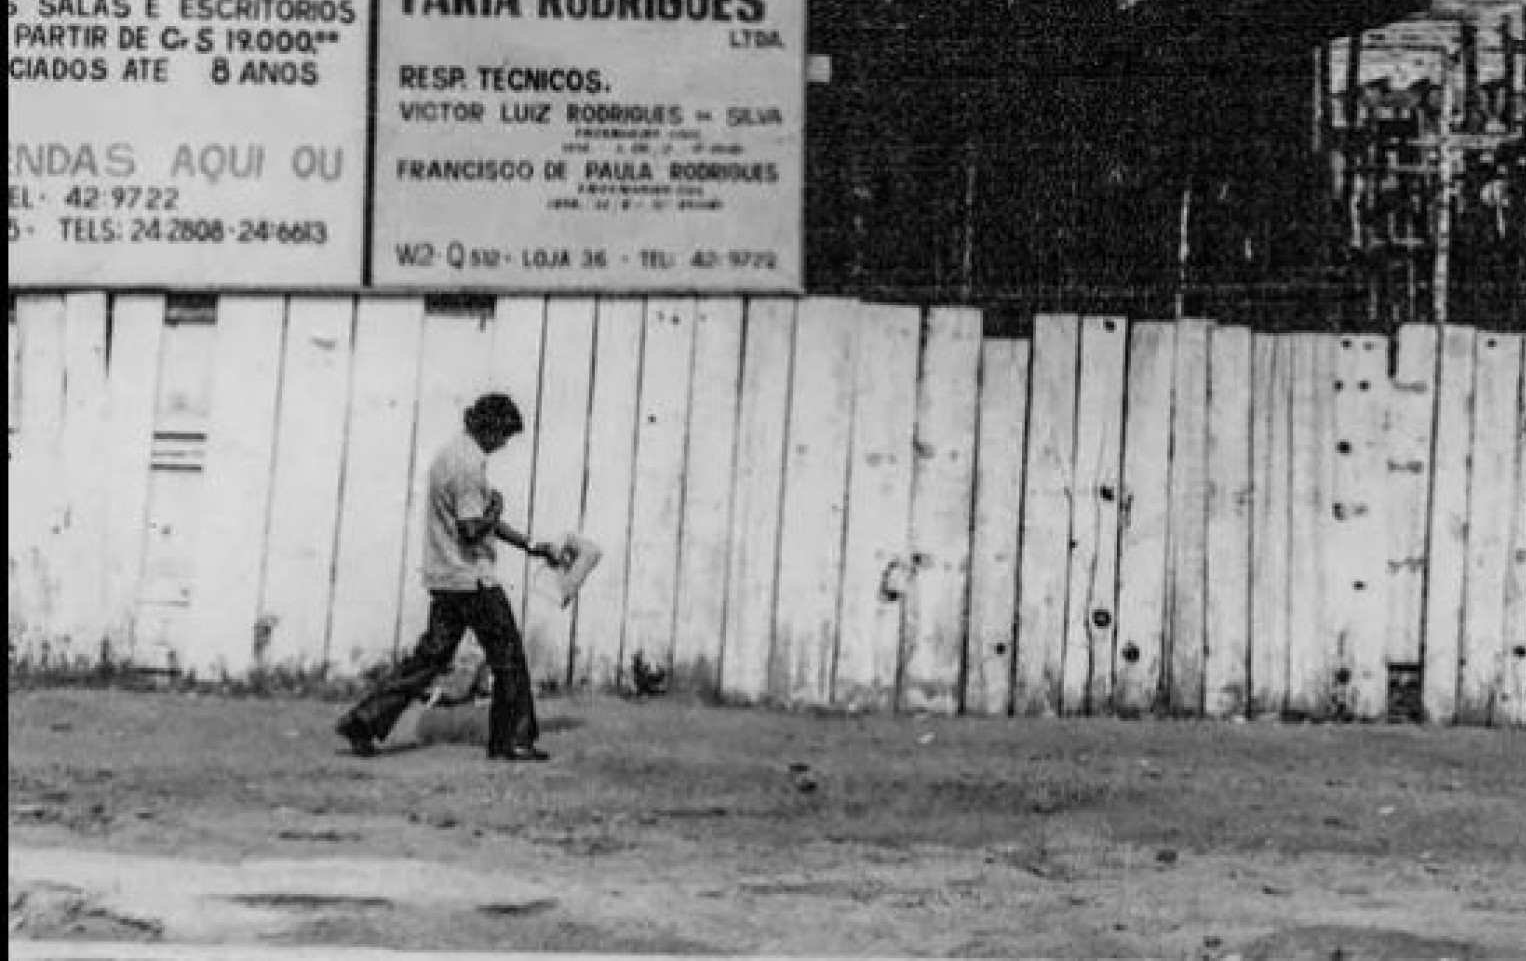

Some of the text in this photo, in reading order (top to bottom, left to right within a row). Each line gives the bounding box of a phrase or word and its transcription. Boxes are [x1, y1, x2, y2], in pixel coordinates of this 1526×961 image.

[15, 23, 107, 49] PARTIR
[118, 25, 149, 50] DE
[10, 57, 107, 82] CIADOS
[211, 56, 230, 85] 8
[239, 60, 319, 86] ANOS
[398, 101, 486, 126] VICTOR
[501, 102, 552, 126] LUIZ
[565, 103, 683, 127] RODRIGUES
[9, 142, 344, 185] NDAS AQUI OU
[396, 159, 781, 185] FRANCISCO DE PAULA RODRIGUES
